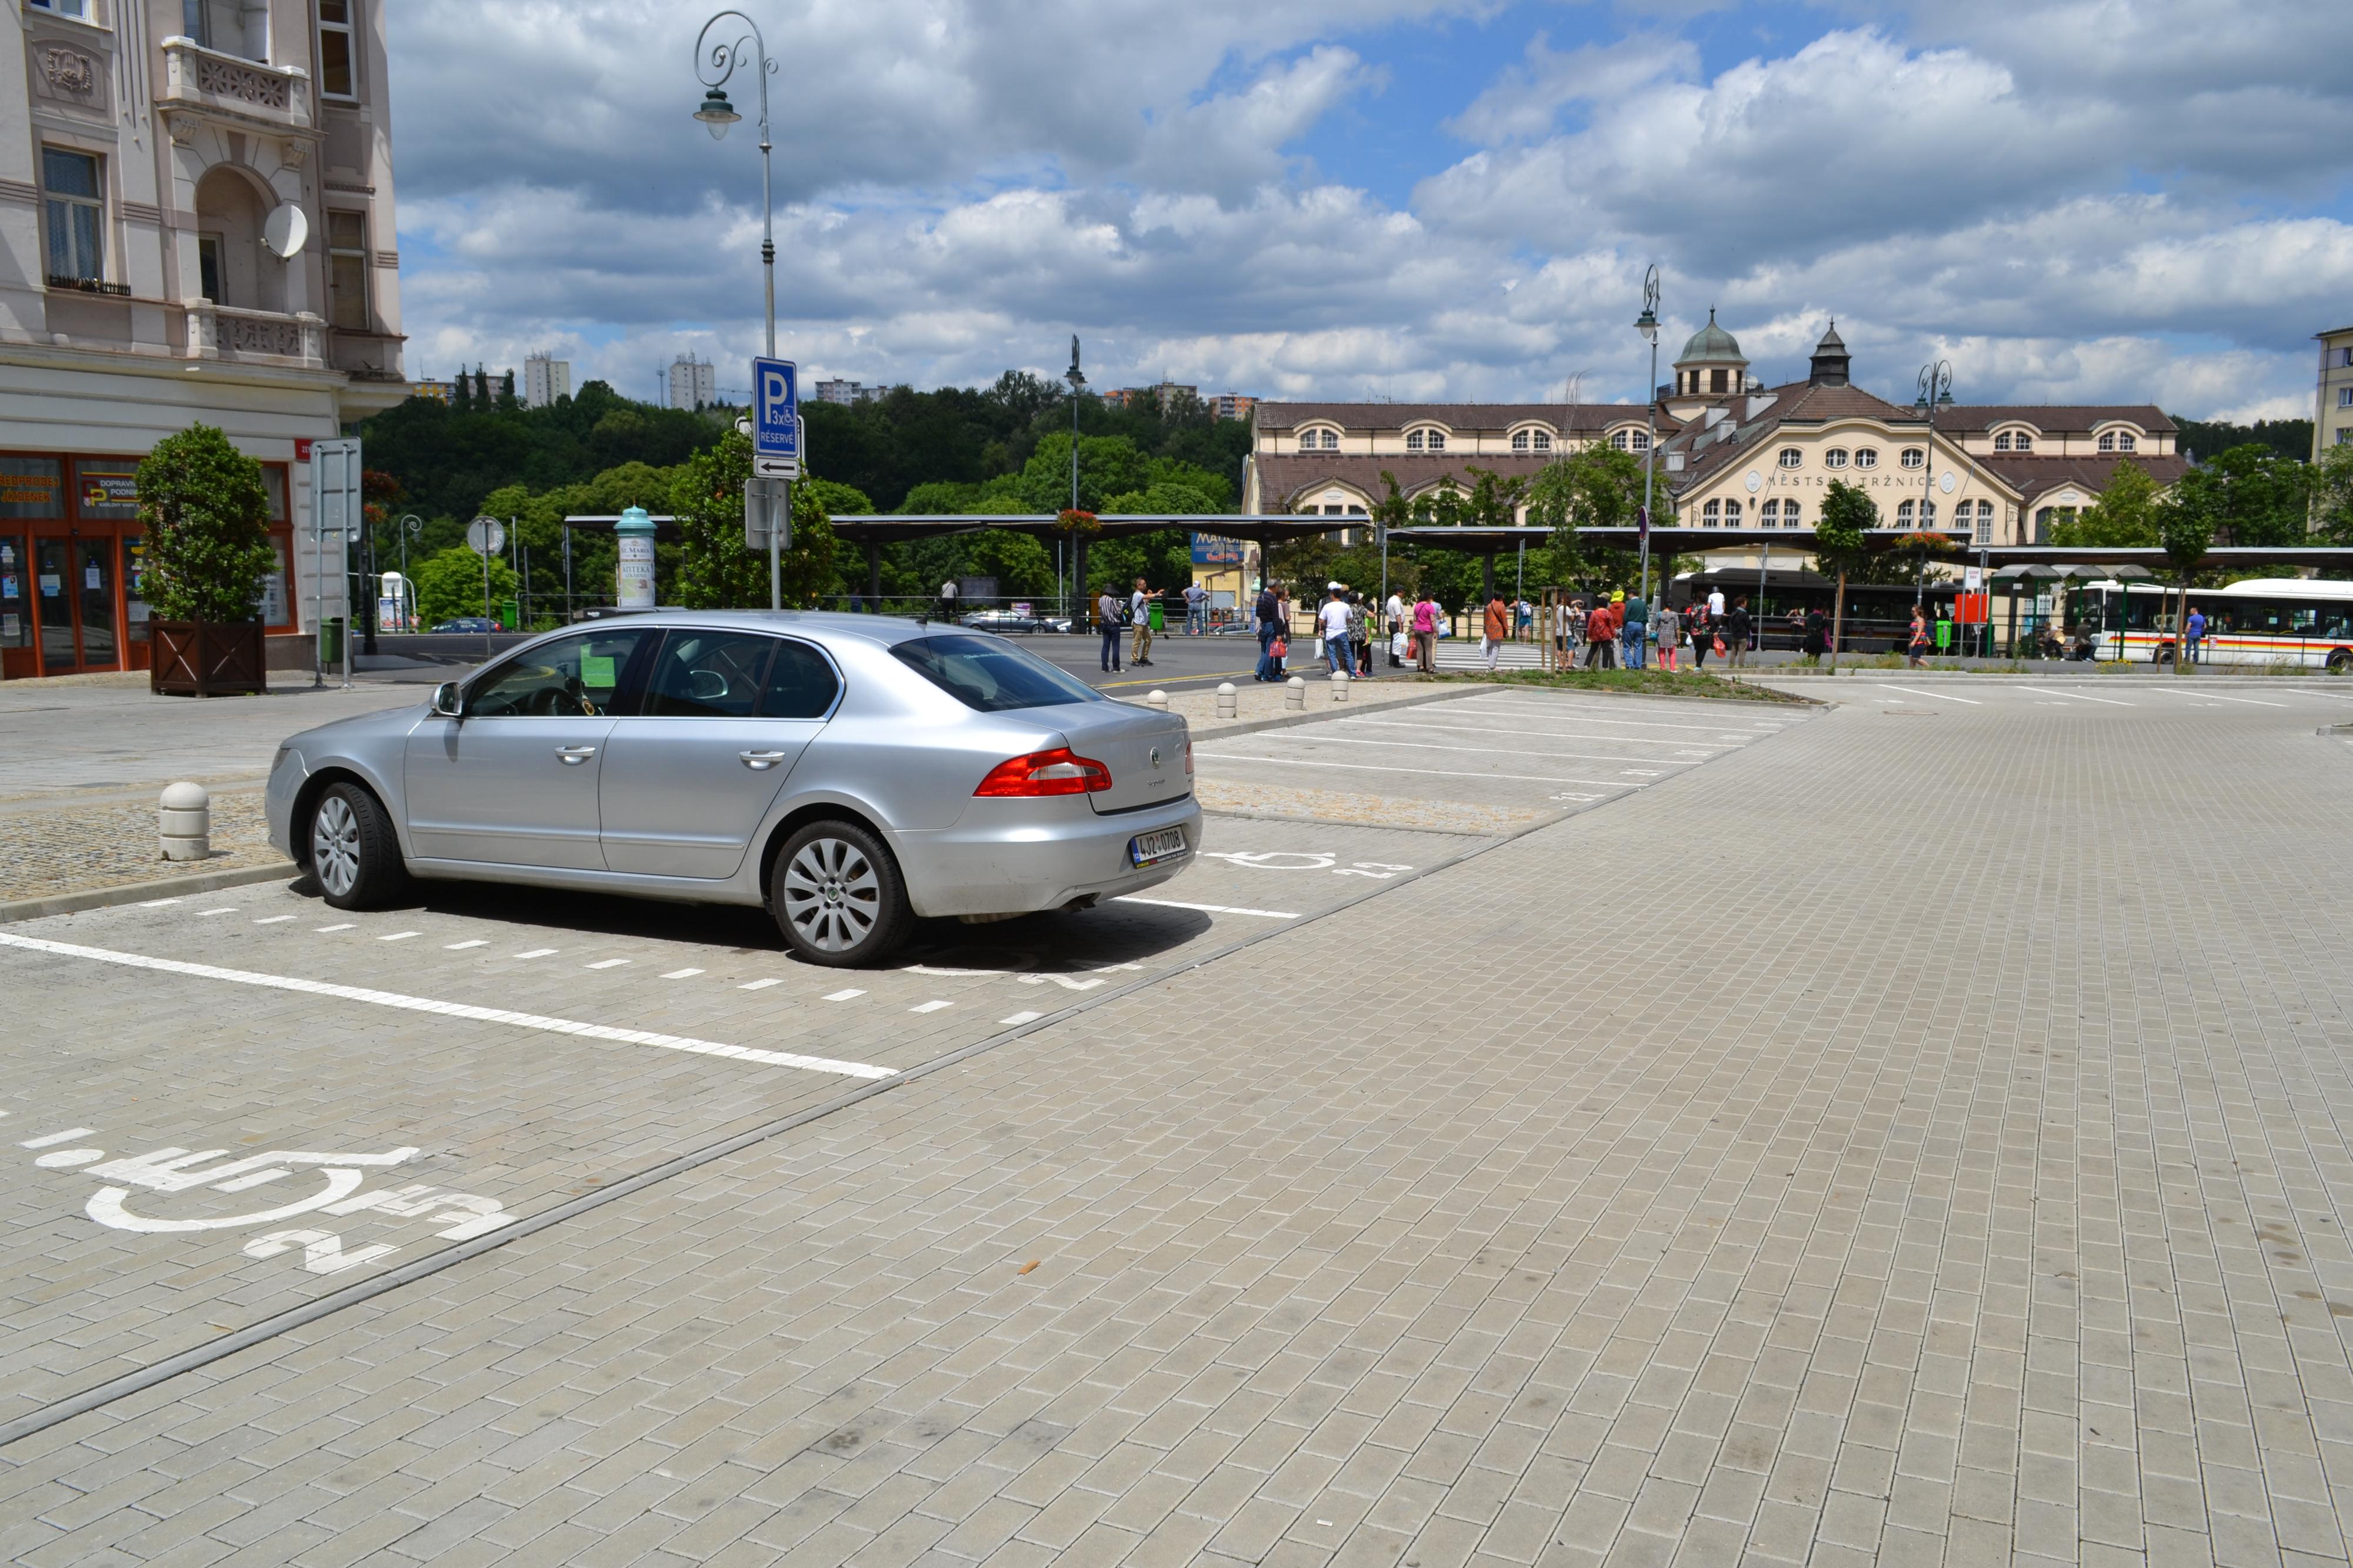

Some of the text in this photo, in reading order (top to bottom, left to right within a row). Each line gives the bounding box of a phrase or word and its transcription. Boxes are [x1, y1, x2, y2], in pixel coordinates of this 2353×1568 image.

[764, 371, 788, 423] P
[772, 410, 784, 425] 3x
[761, 430, 794, 445] RÉSERVÉ
[1766, 474, 1936, 486] MĚSTSKÁ TRŽNICE
[1139, 836, 1157, 857] 4J2
[1160, 830, 1181, 851] 0708
[1332, 862, 1414, 879] 23
[242, 1183, 504, 1276] 25
